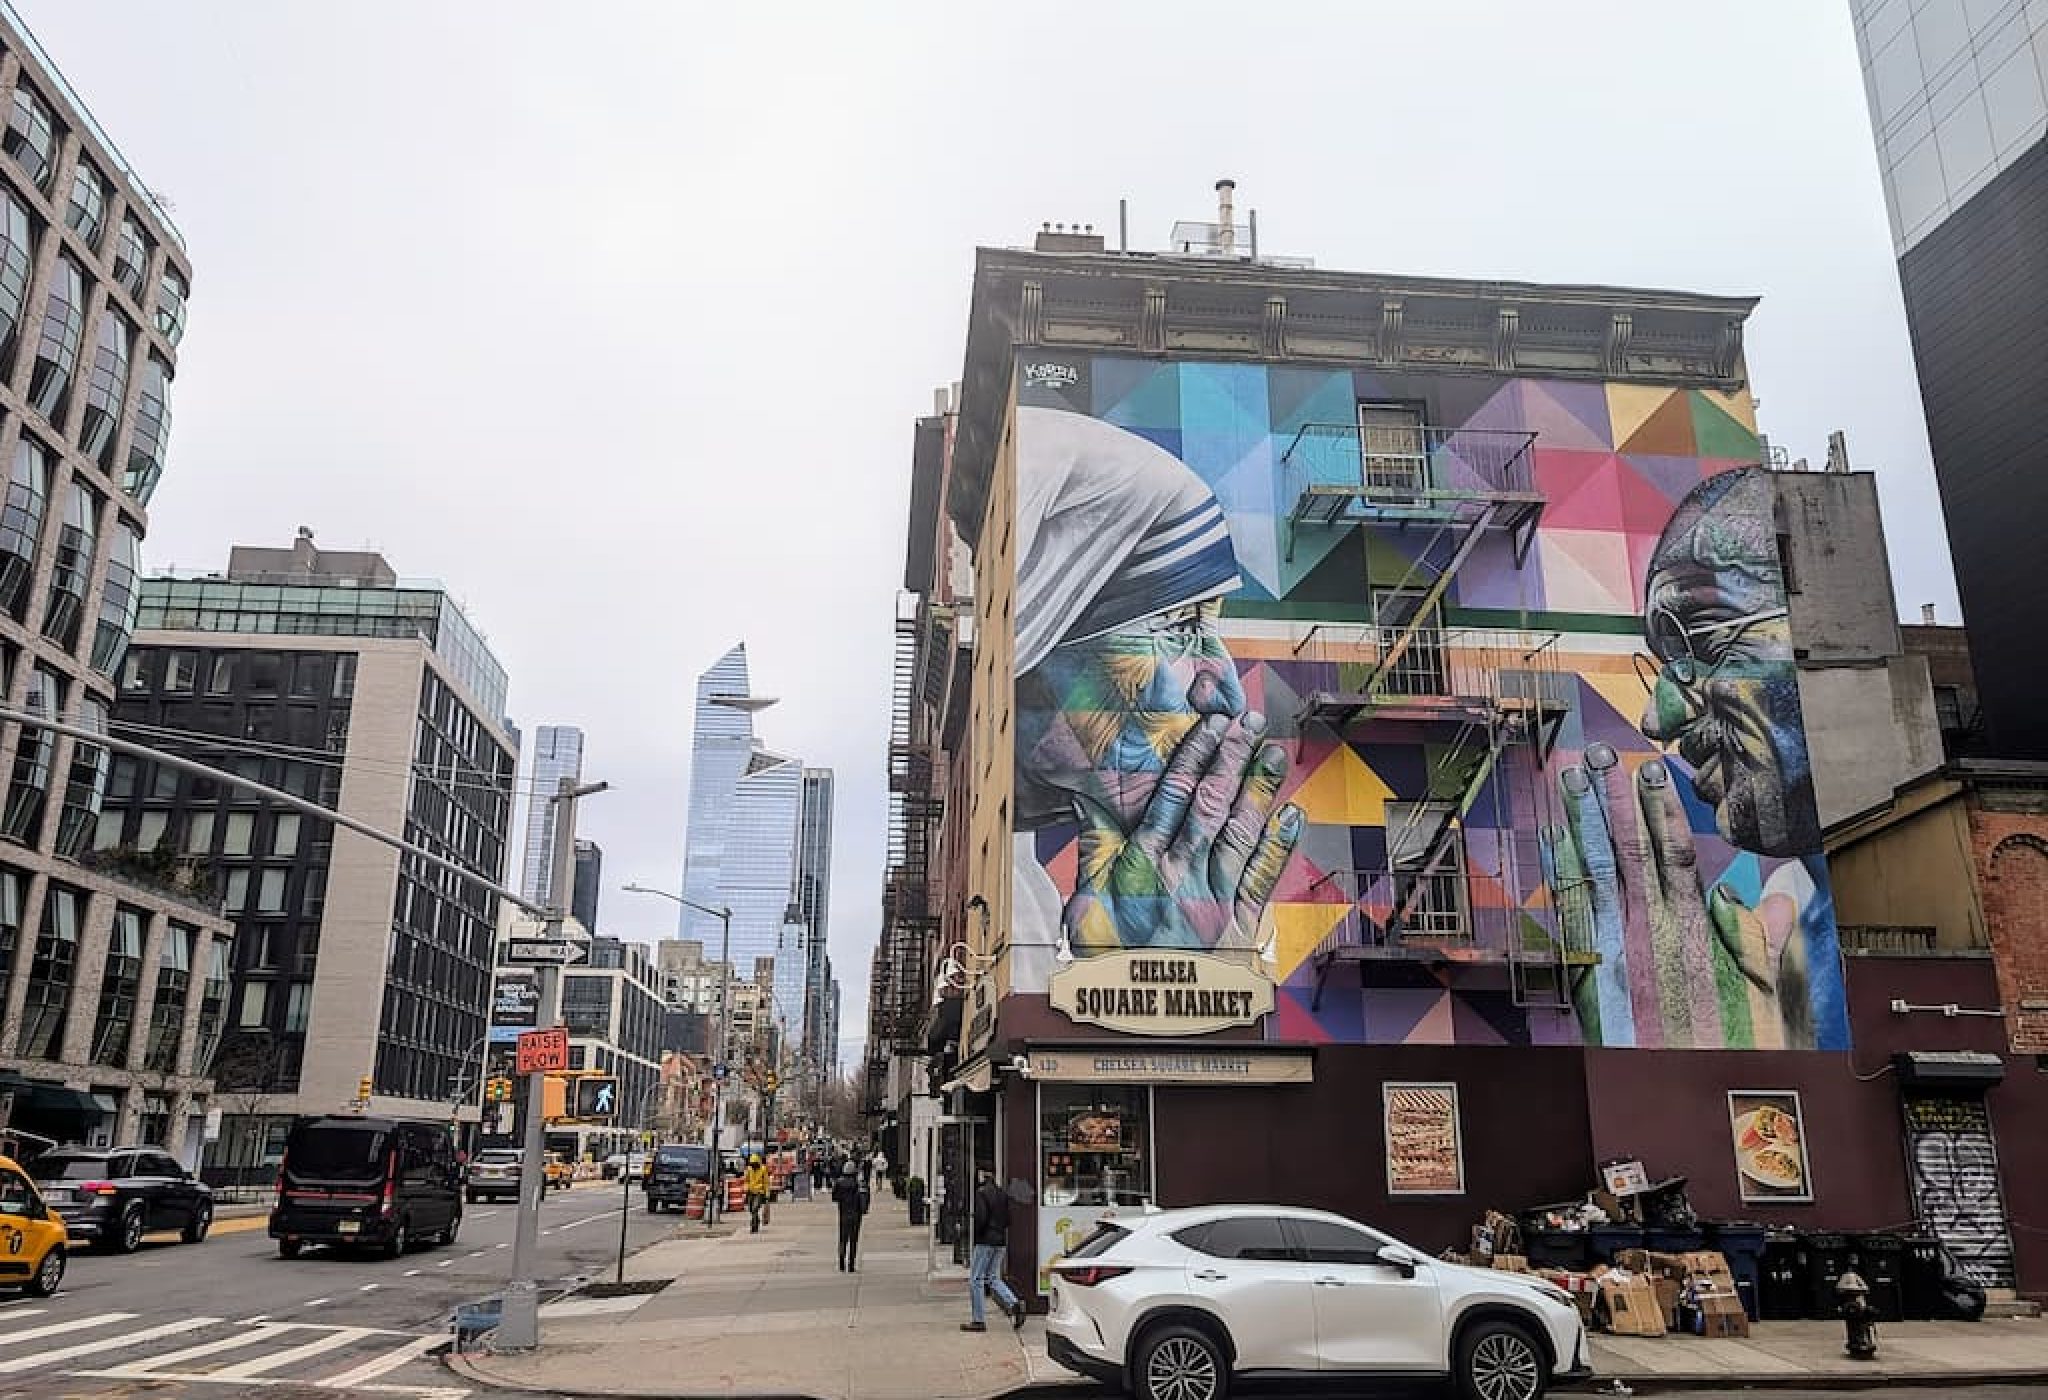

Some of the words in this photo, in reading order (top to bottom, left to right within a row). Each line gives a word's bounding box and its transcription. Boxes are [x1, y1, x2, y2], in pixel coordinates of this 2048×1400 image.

[1129, 959, 1198, 983] CHELSEA
[1076, 987, 1158, 1018] SQUARE
[1164, 988, 1253, 1018] MARKET
[521, 1035, 561, 1050] RAISE
[523, 1052, 560, 1068] PLOW
